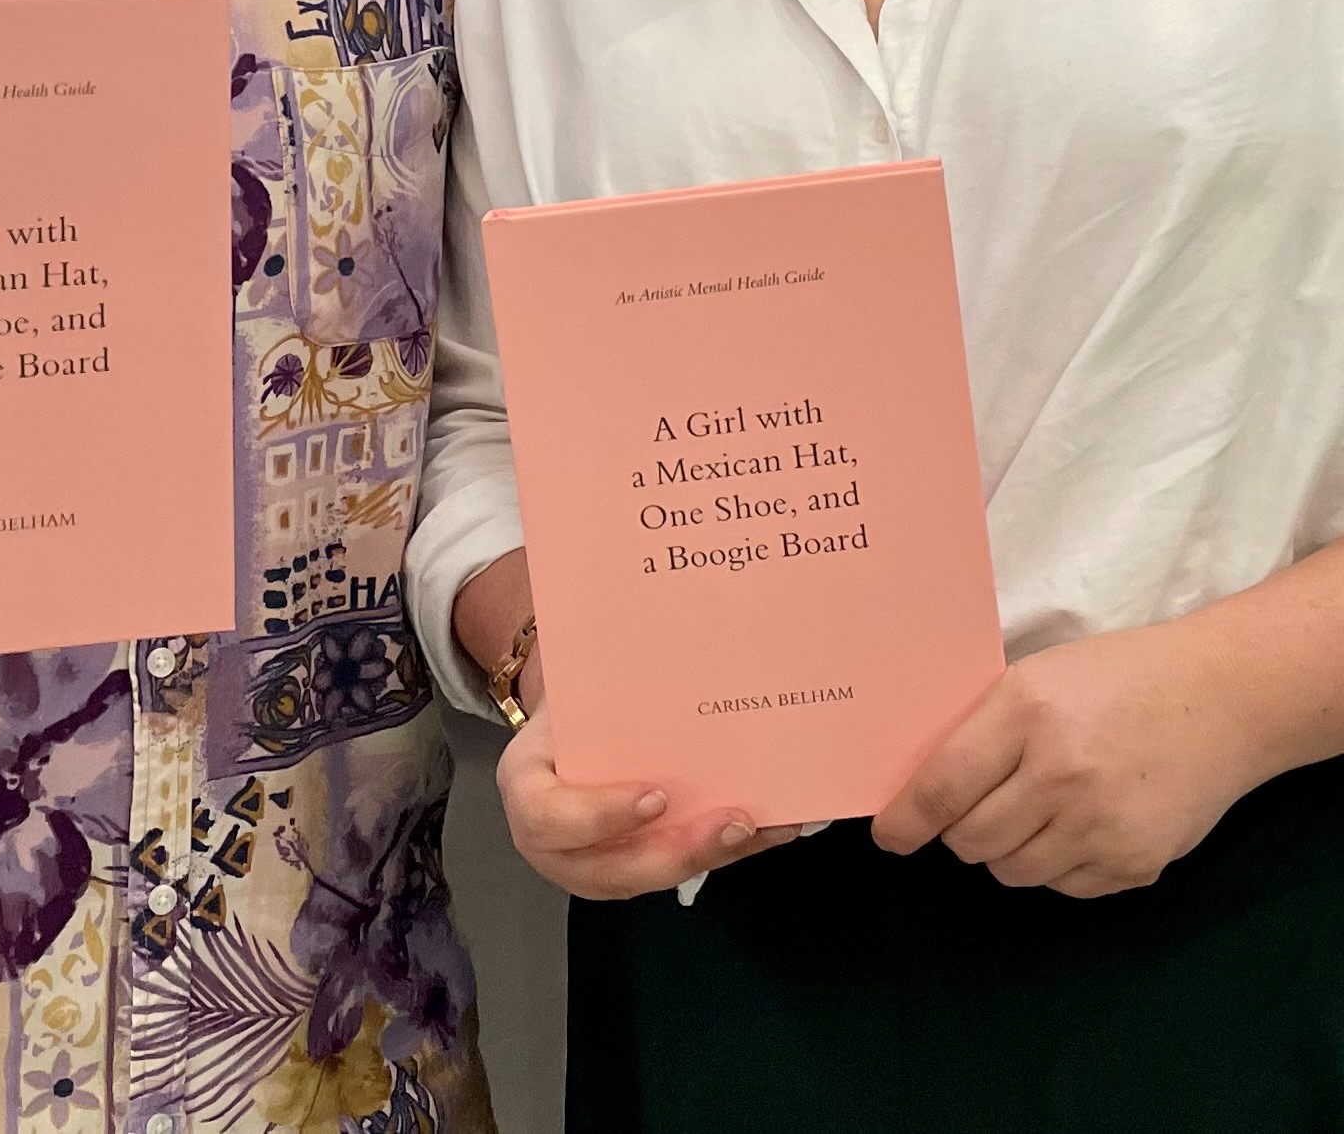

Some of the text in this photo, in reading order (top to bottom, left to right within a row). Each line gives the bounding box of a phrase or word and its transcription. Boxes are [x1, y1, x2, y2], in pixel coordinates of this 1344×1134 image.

[1, 82, 49, 100] Health
[53, 80, 97, 97] Guide
[6, 215, 78, 246] with
[41, 261, 109, 289] Hat,
[614, 266, 826, 306] An Artistic Mental Health Guide
[51, 302, 107, 332] and
[17, 345, 110, 379] Board
[652, 398, 824, 443] A Girl with
[631, 442, 858, 489] a Mexican Hat,
[639, 479, 861, 531] One Shoe, and
[642, 522, 870, 575] a Boogie Board
[697, 685, 854, 716] CARISSA BELHAM
